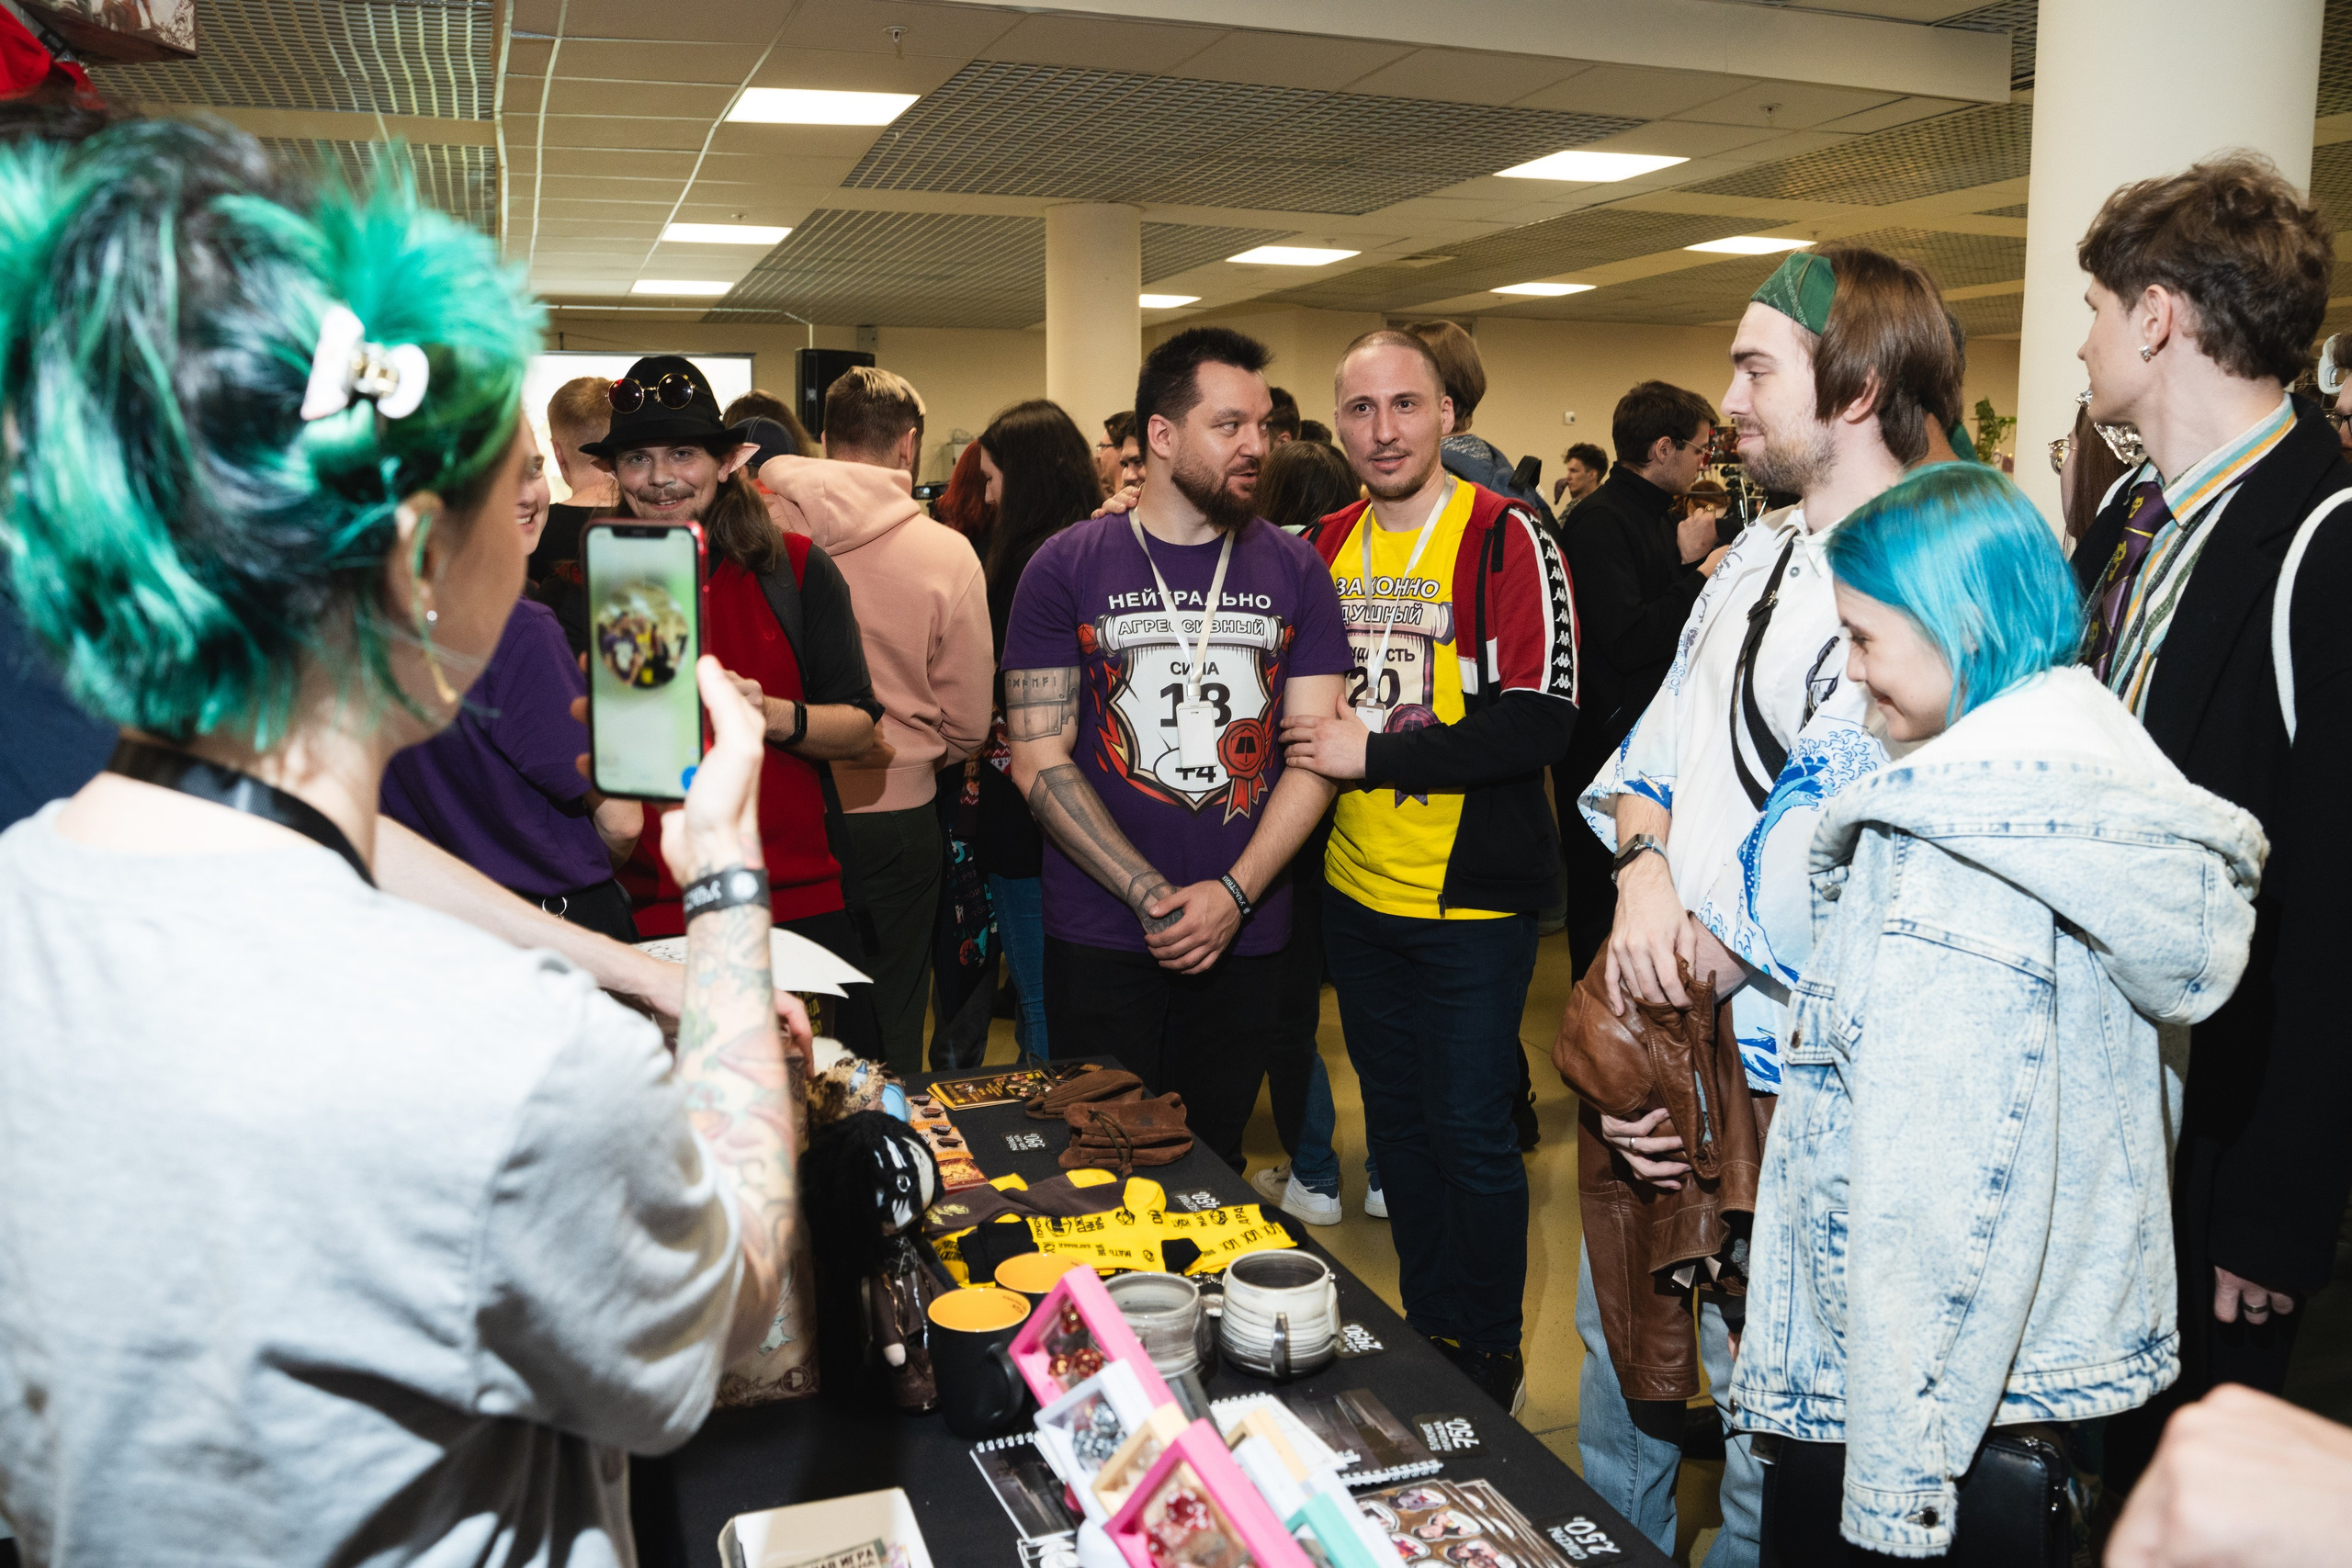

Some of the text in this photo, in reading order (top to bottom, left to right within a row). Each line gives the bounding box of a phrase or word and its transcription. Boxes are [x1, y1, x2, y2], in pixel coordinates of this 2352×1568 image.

[1108, 588, 1272, 610] НЕЙРАЬНО
[1170, 661, 1219, 675] СИА
[1348, 666, 1400, 710] 20
[1160, 682, 1232, 728] 18
